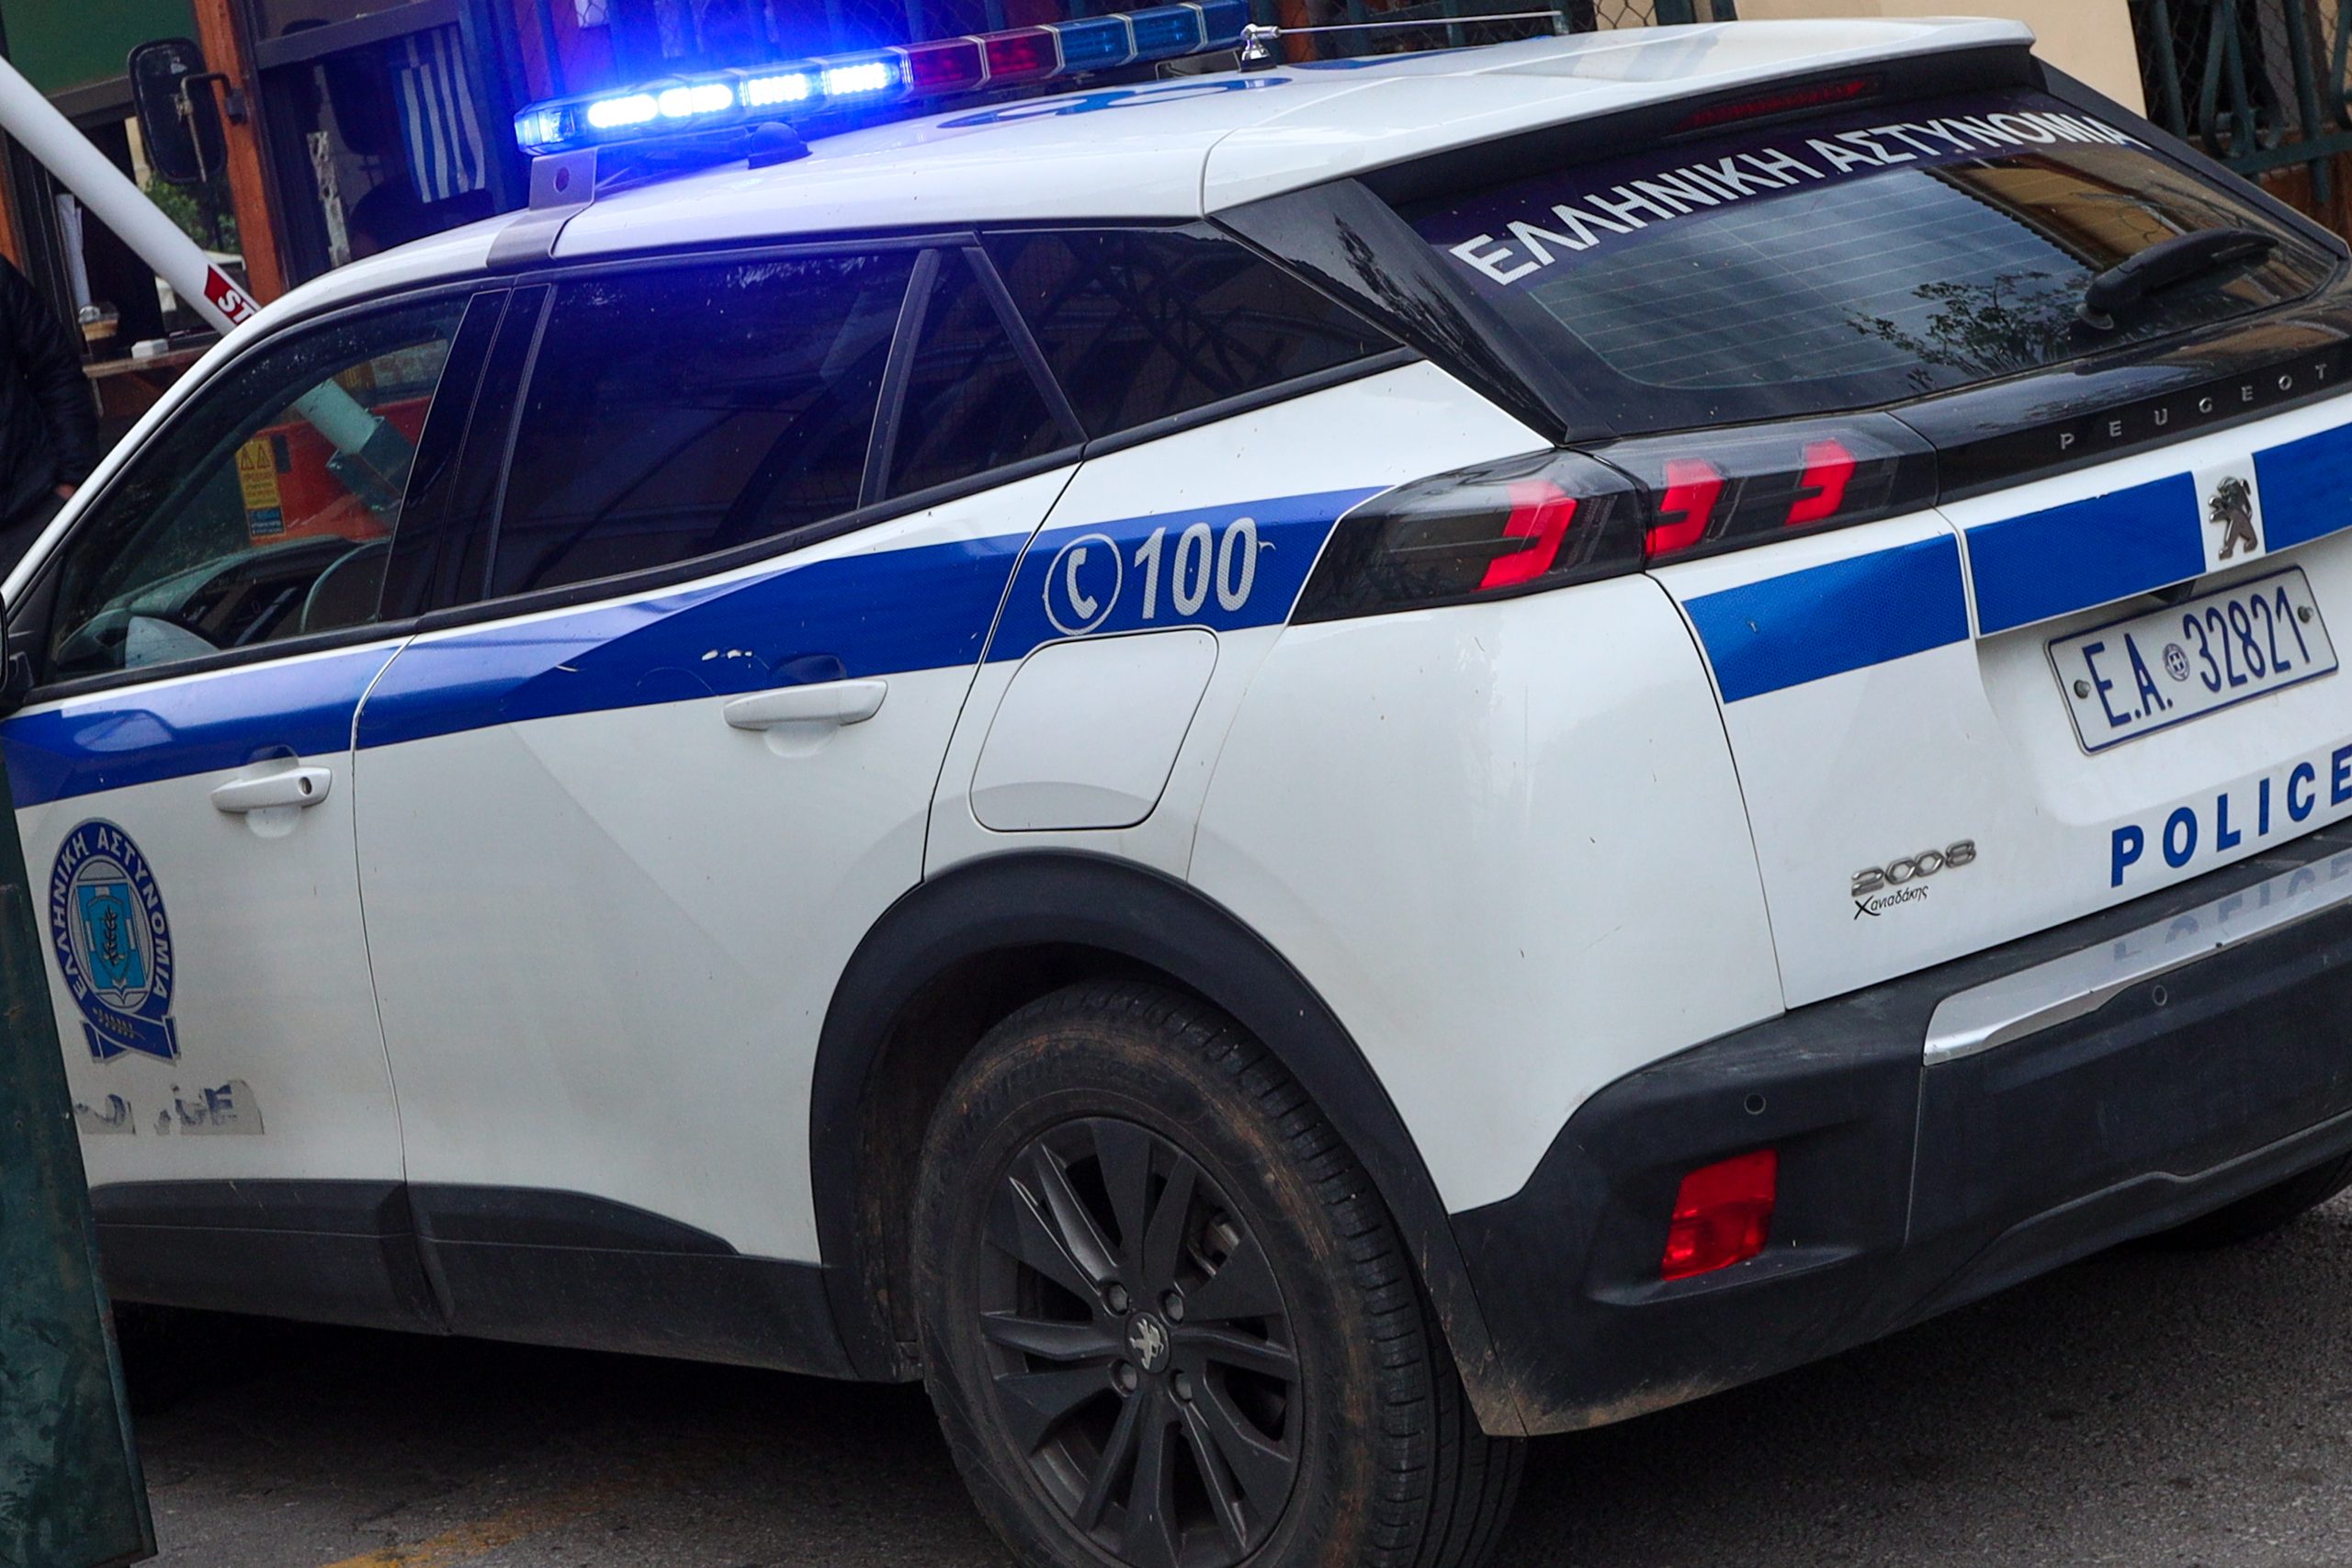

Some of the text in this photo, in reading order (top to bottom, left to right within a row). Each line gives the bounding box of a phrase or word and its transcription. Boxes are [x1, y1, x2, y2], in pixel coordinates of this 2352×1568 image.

[1448, 112, 2154, 286] ΕΛΛΗΝΙΚΗ ΑΣΤΥΝΟΜΙΑ
[2060, 364, 2327, 450] PEUGEOT
[1134, 516, 1258, 619] 100
[2182, 586, 2311, 692] 32821
[1851, 839, 1977, 897] 2008
[2111, 744, 2352, 888] POLICE
[52, 827, 170, 1000] ΕΛΛΗΝΙΚΗ ΑΣΤΥΝΟΜΙΑ
[1854, 885, 1929, 919] Χανιαδάκης
